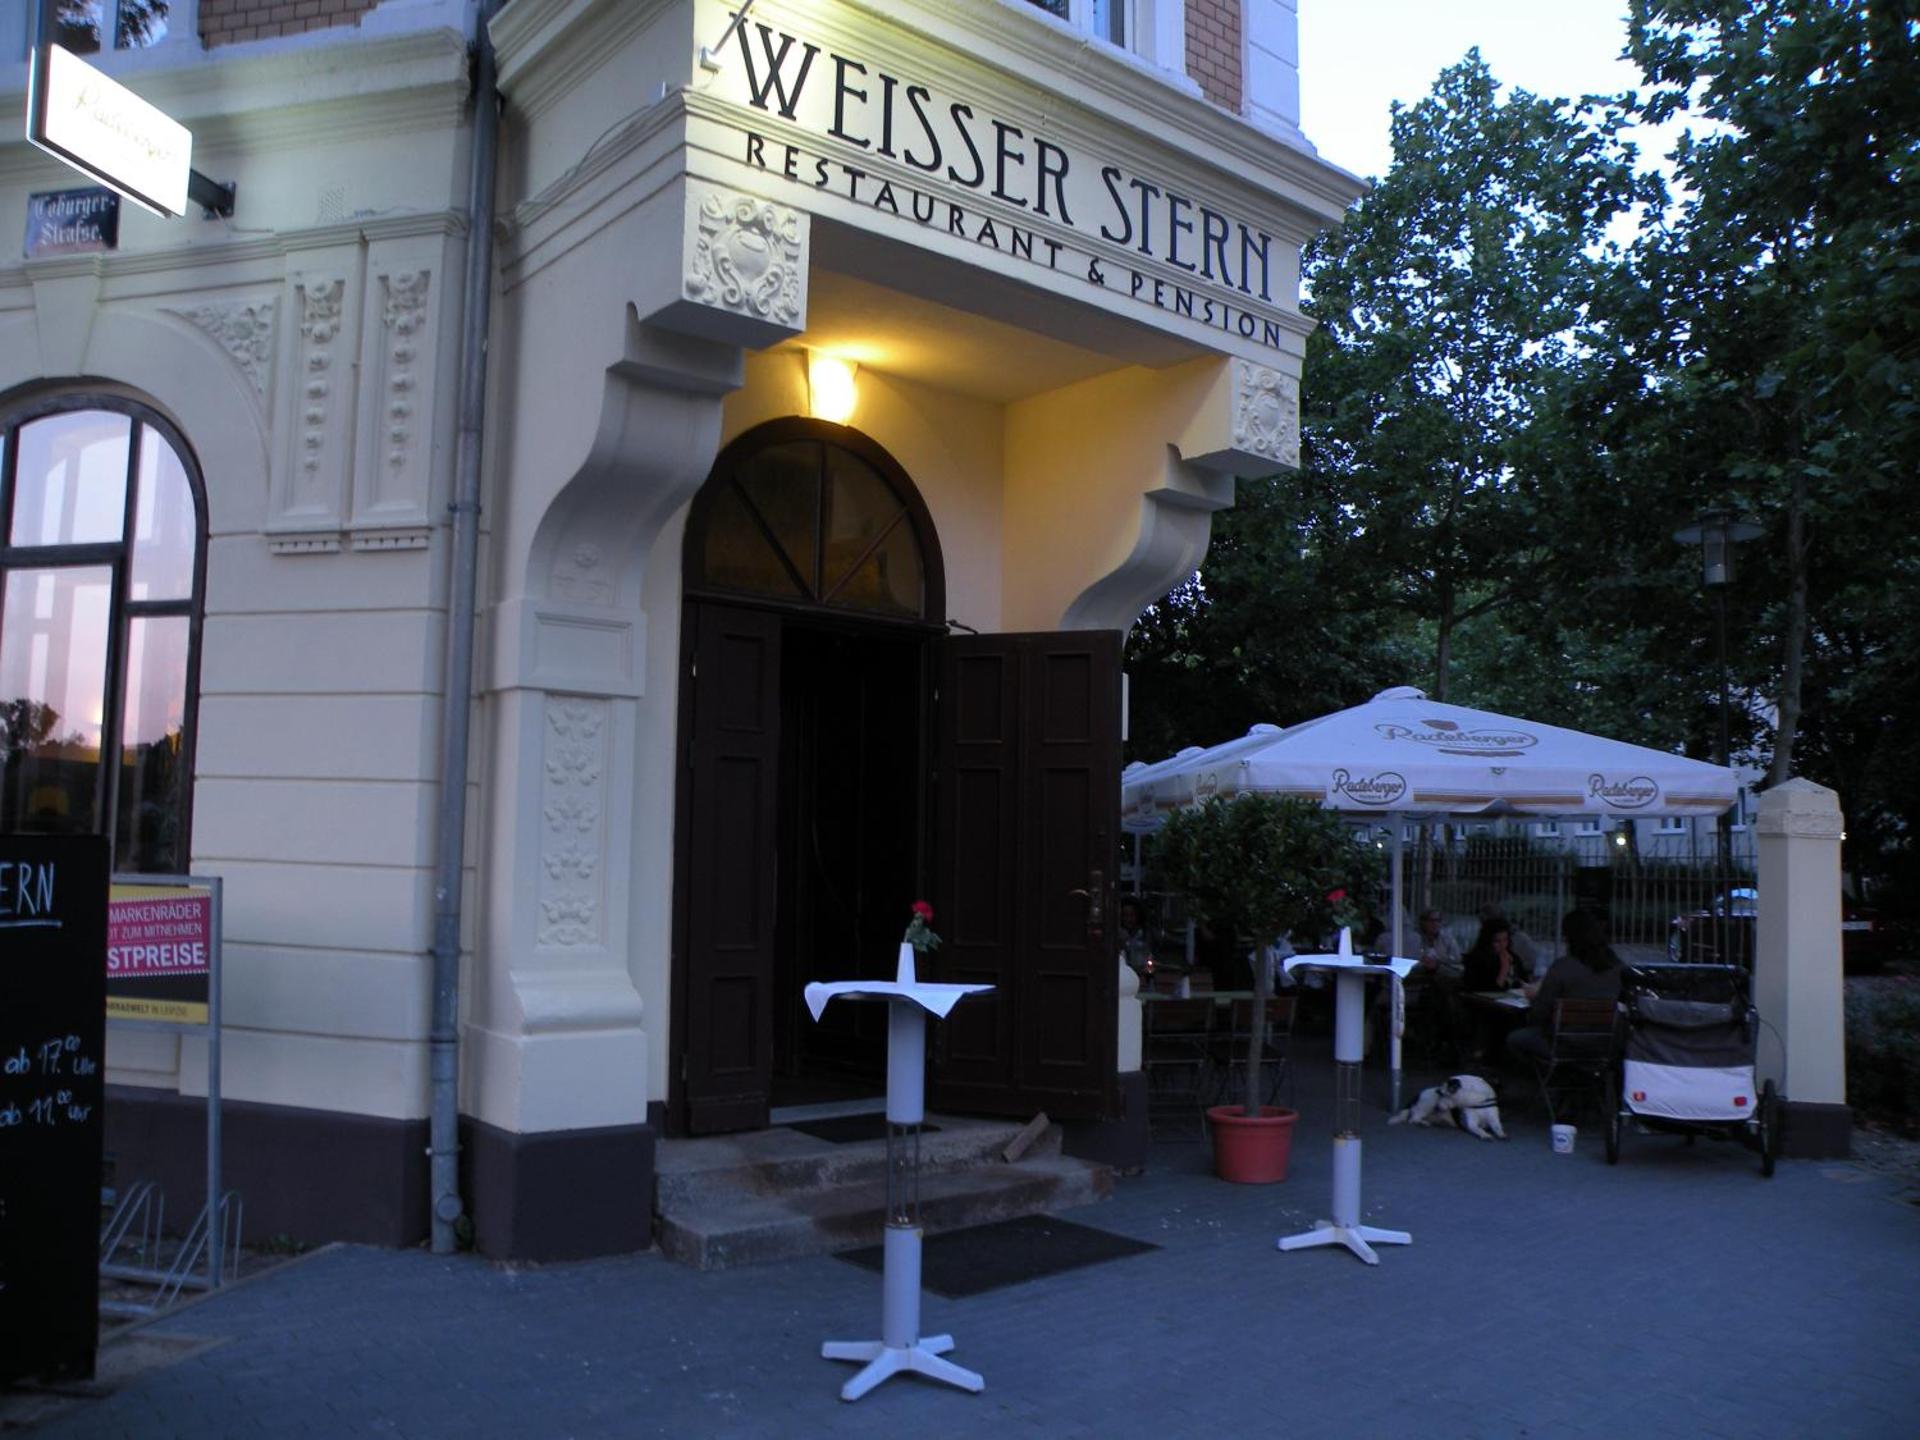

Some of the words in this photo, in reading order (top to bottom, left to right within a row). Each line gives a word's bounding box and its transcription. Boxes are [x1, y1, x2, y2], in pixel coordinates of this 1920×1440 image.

[729, 11, 1074, 227] WEISSER
[1100, 165, 1273, 304] STERN
[744, 131, 1065, 270] RESTAURANT
[1087, 257, 1106, 285] &
[1131, 271, 1281, 350] PENSION
[1374, 724, 1538, 750] Radeberger
[1332, 768, 1407, 805] Radeberger
[1588, 773, 1659, 809] Radeberger
[4, 1046, 31, 1075] ab
